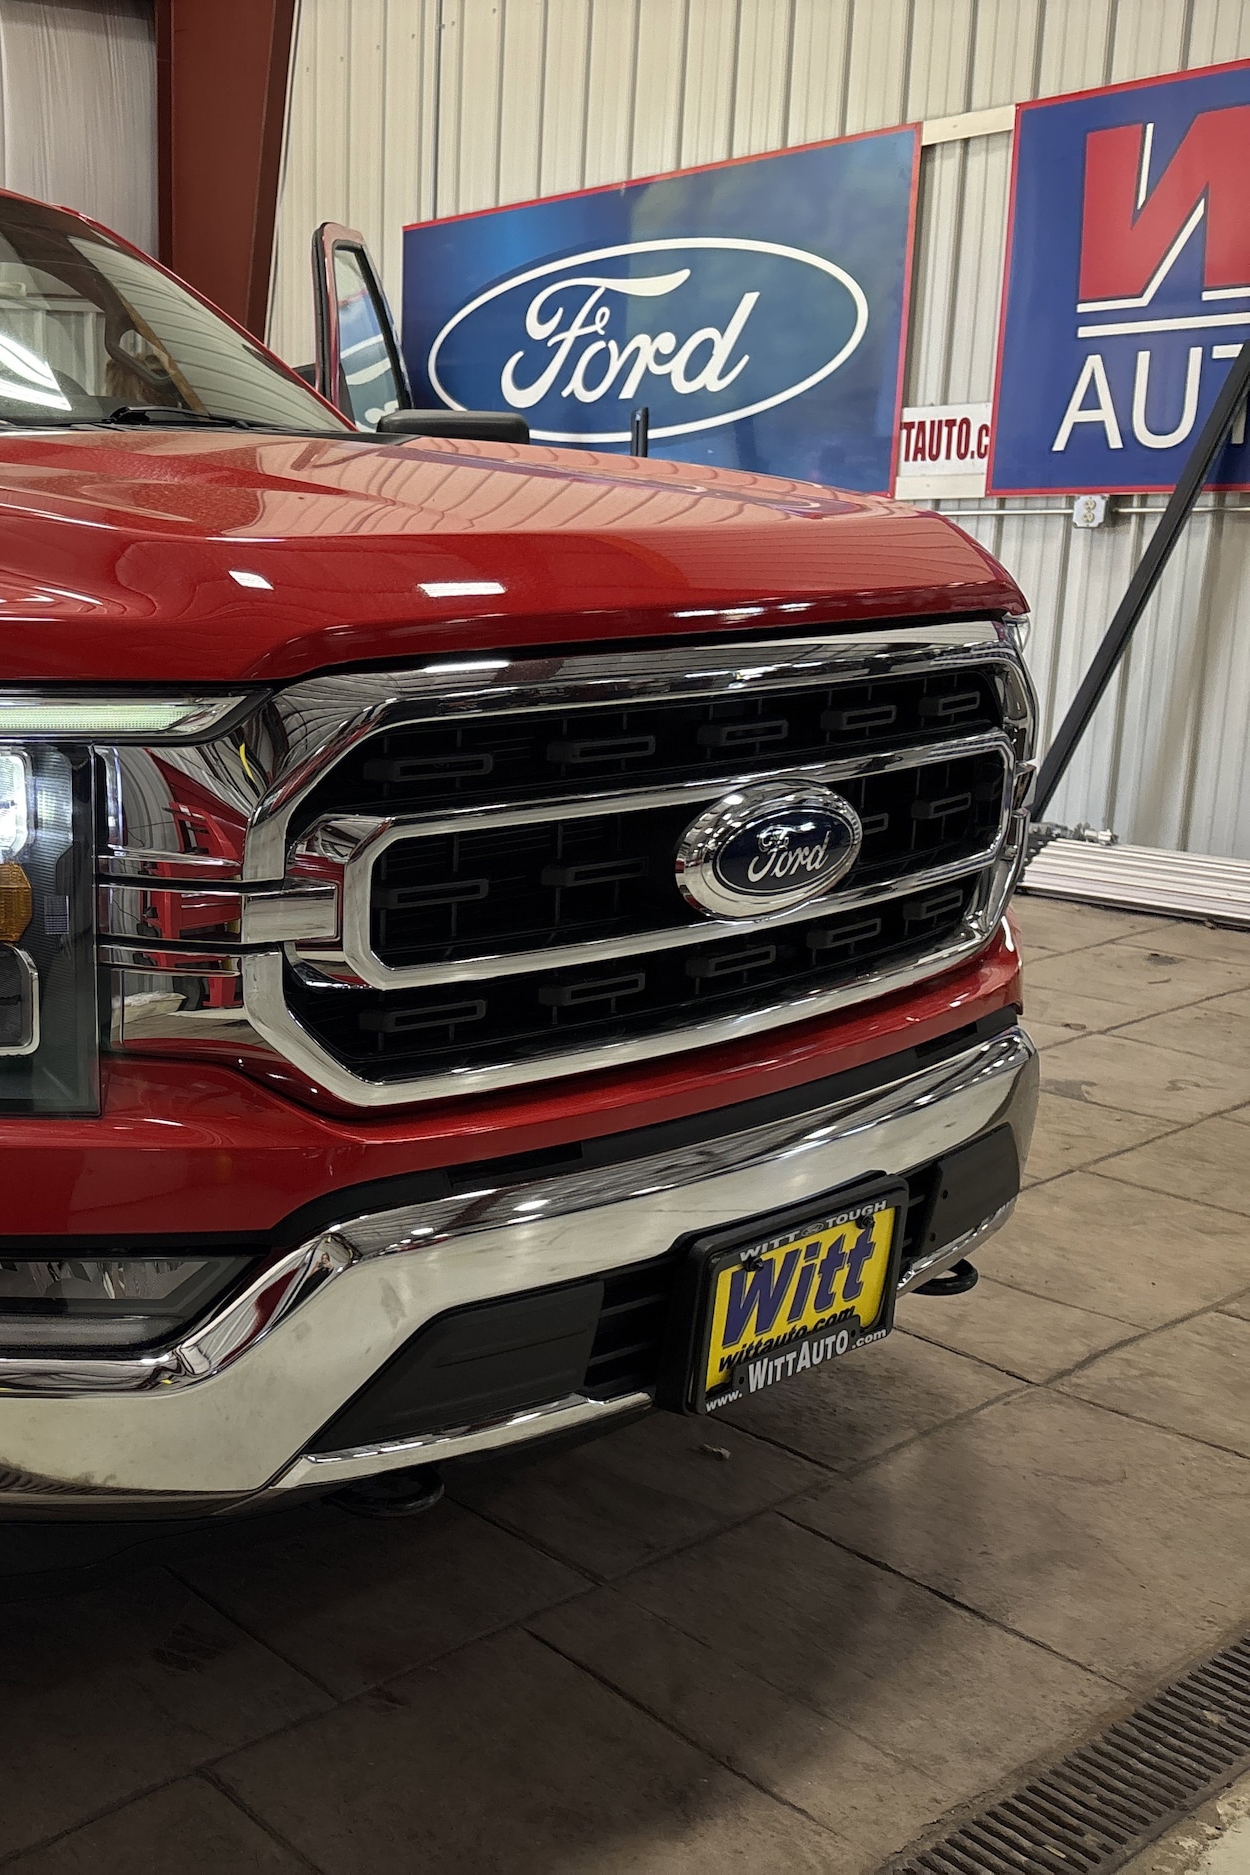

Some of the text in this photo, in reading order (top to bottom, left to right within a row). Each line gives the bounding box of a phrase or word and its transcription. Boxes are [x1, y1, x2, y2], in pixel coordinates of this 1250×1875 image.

[501, 268, 760, 409] Ford
[900, 417, 990, 463] TAUTO.c
[747, 821, 833, 883] Ford
[739, 1200, 887, 1262] WITT TOUGH
[722, 1227, 876, 1349] Witt
